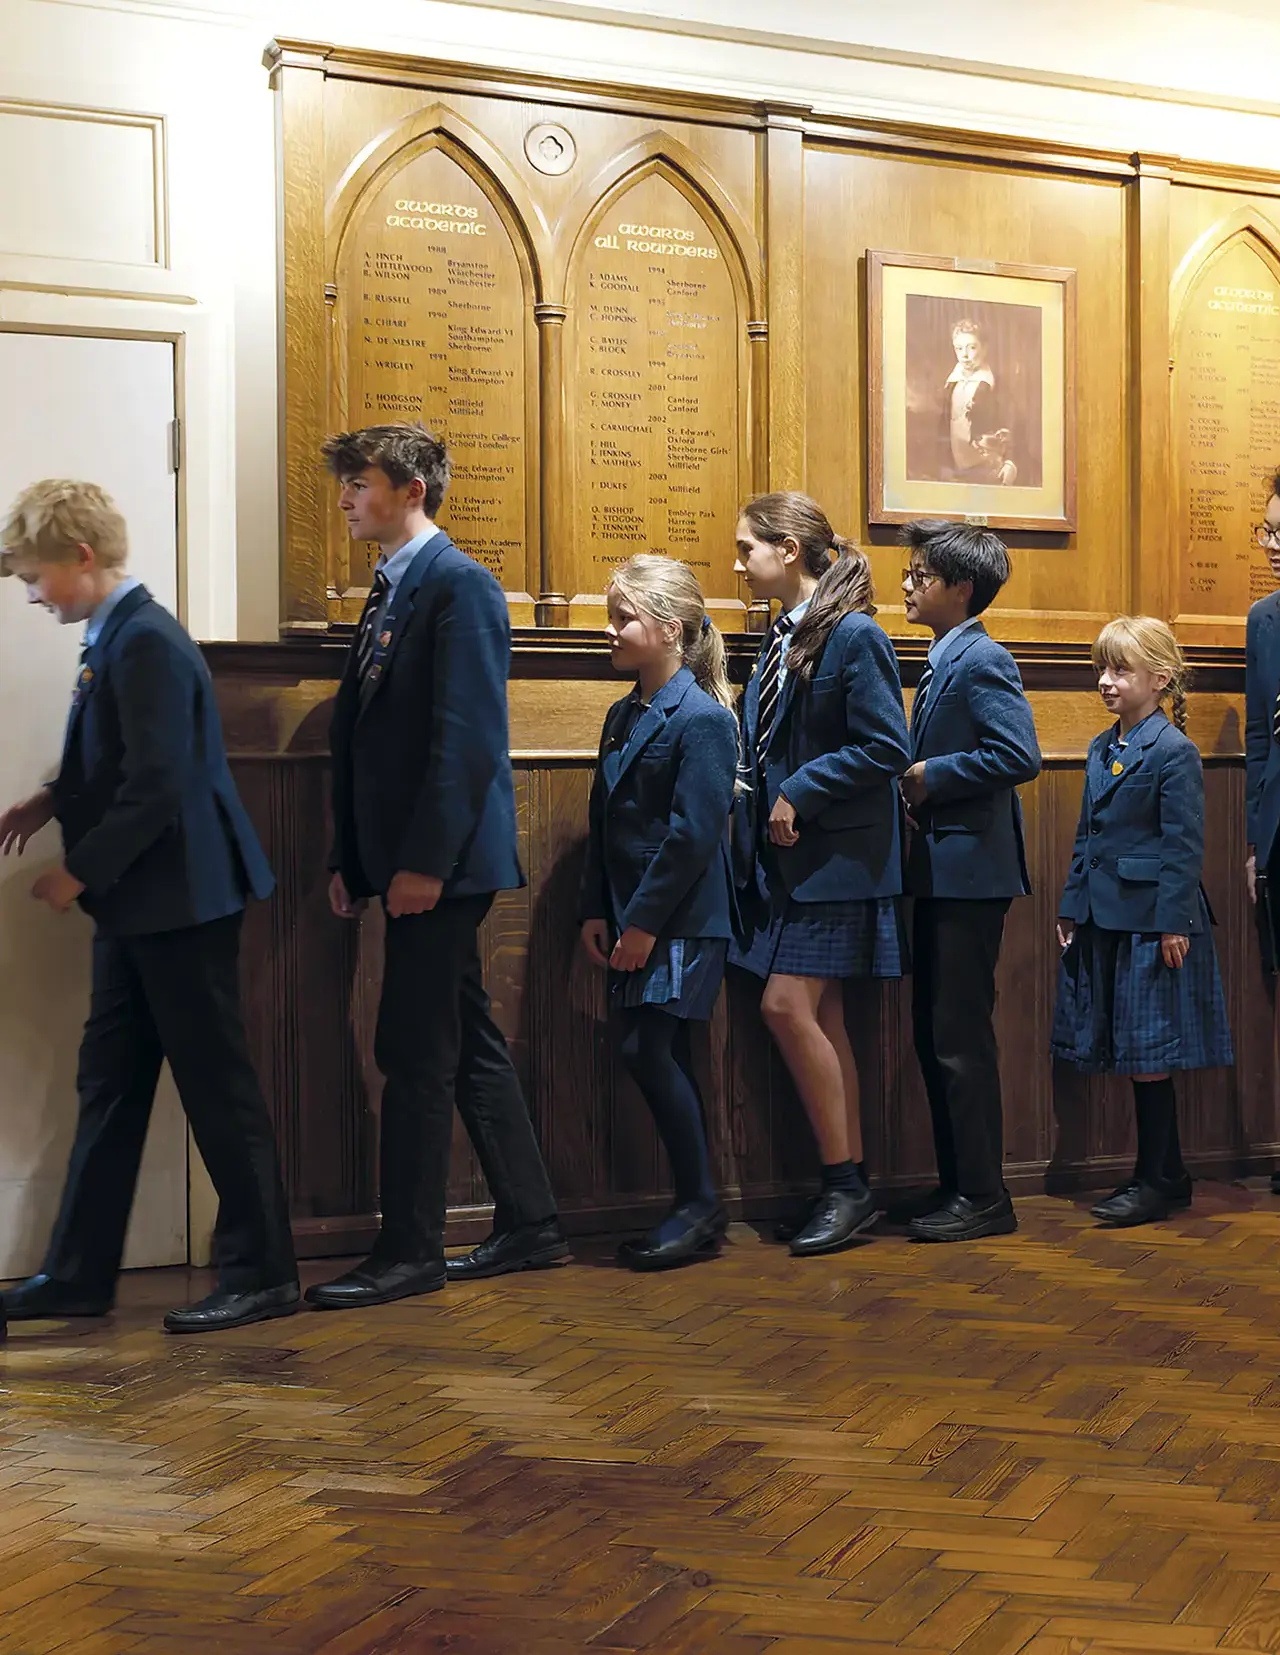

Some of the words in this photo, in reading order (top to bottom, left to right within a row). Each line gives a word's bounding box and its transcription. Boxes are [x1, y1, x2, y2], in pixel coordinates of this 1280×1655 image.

[386, 215, 487, 236] academic
[594, 235, 620, 250] all
[374, 270, 411, 280] WILSON
[447, 268, 496, 279] Winchester
[600, 273, 628, 282] ADAMS
[447, 277, 496, 288] Winchester
[667, 279, 707, 290] Sherborne
[600, 283, 640, 293] GOODALL
[374, 294, 411, 304] RUSSELL
[447, 300, 492, 311] Sherborne
[603, 305, 628, 314] DUNN
[601, 314, 637, 324] HOPKINS
[447, 324, 467, 334] King
[470, 326, 501, 336] Edward
[377, 336, 389, 345] DE
[447, 332, 505, 344] Southampton
[448, 341, 492, 352] Sherborne
[599, 346, 626, 354] BLOCK
[448, 366, 468, 376] King
[470, 367, 501, 377] Edward
[601, 369, 641, 378] CROSSLEY
[448, 374, 505, 386] Southampton
[667, 374, 698, 382] Canford
[428, 385, 448, 394] 1992
[648, 384, 666, 392] 2001
[376, 394, 423, 403] HODGSON
[602, 392, 641, 401] CROSSLEY
[667, 396, 698, 405] Canford
[449, 398, 484, 408] Millfield
[600, 400, 630, 409] MONEY
[449, 407, 484, 417] Millfield
[667, 405, 698, 413] Canford
[648, 415, 667, 423] 2002
[600, 424, 652, 433] CARMICHAEL
[680, 429, 715, 437] Edward's
[448, 431, 488, 441] University
[491, 434, 521, 443] College
[667, 437, 695, 445] Oxford
[449, 439, 476, 448] School
[478, 441, 508, 449] London
[600, 441, 617, 449] HILL
[667, 445, 707, 455] Sherborne
[667, 453, 708, 462] Sherborne
[471, 463, 502, 473] Edward
[602, 459, 641, 468] MATHEWS
[667, 462, 700, 471] Millfield
[450, 473, 506, 483] Southampton
[649, 473, 667, 481] 2003
[600, 482, 627, 490] DUKES
[668, 485, 700, 494] Millfield
[463, 496, 502, 505] Edward's
[450, 505, 480, 513] Oxford
[668, 509, 696, 518] Embley
[450, 514, 498, 523] Winchester
[603, 515, 644, 523] STOGDON
[602, 524, 639, 532] TENNANT
[668, 526, 696, 534] Harrow
[601, 532, 647, 541] THORNTON
[668, 535, 700, 543] Canford
[490, 539, 522, 549] Academy
[459, 546, 505, 556] arlborough
